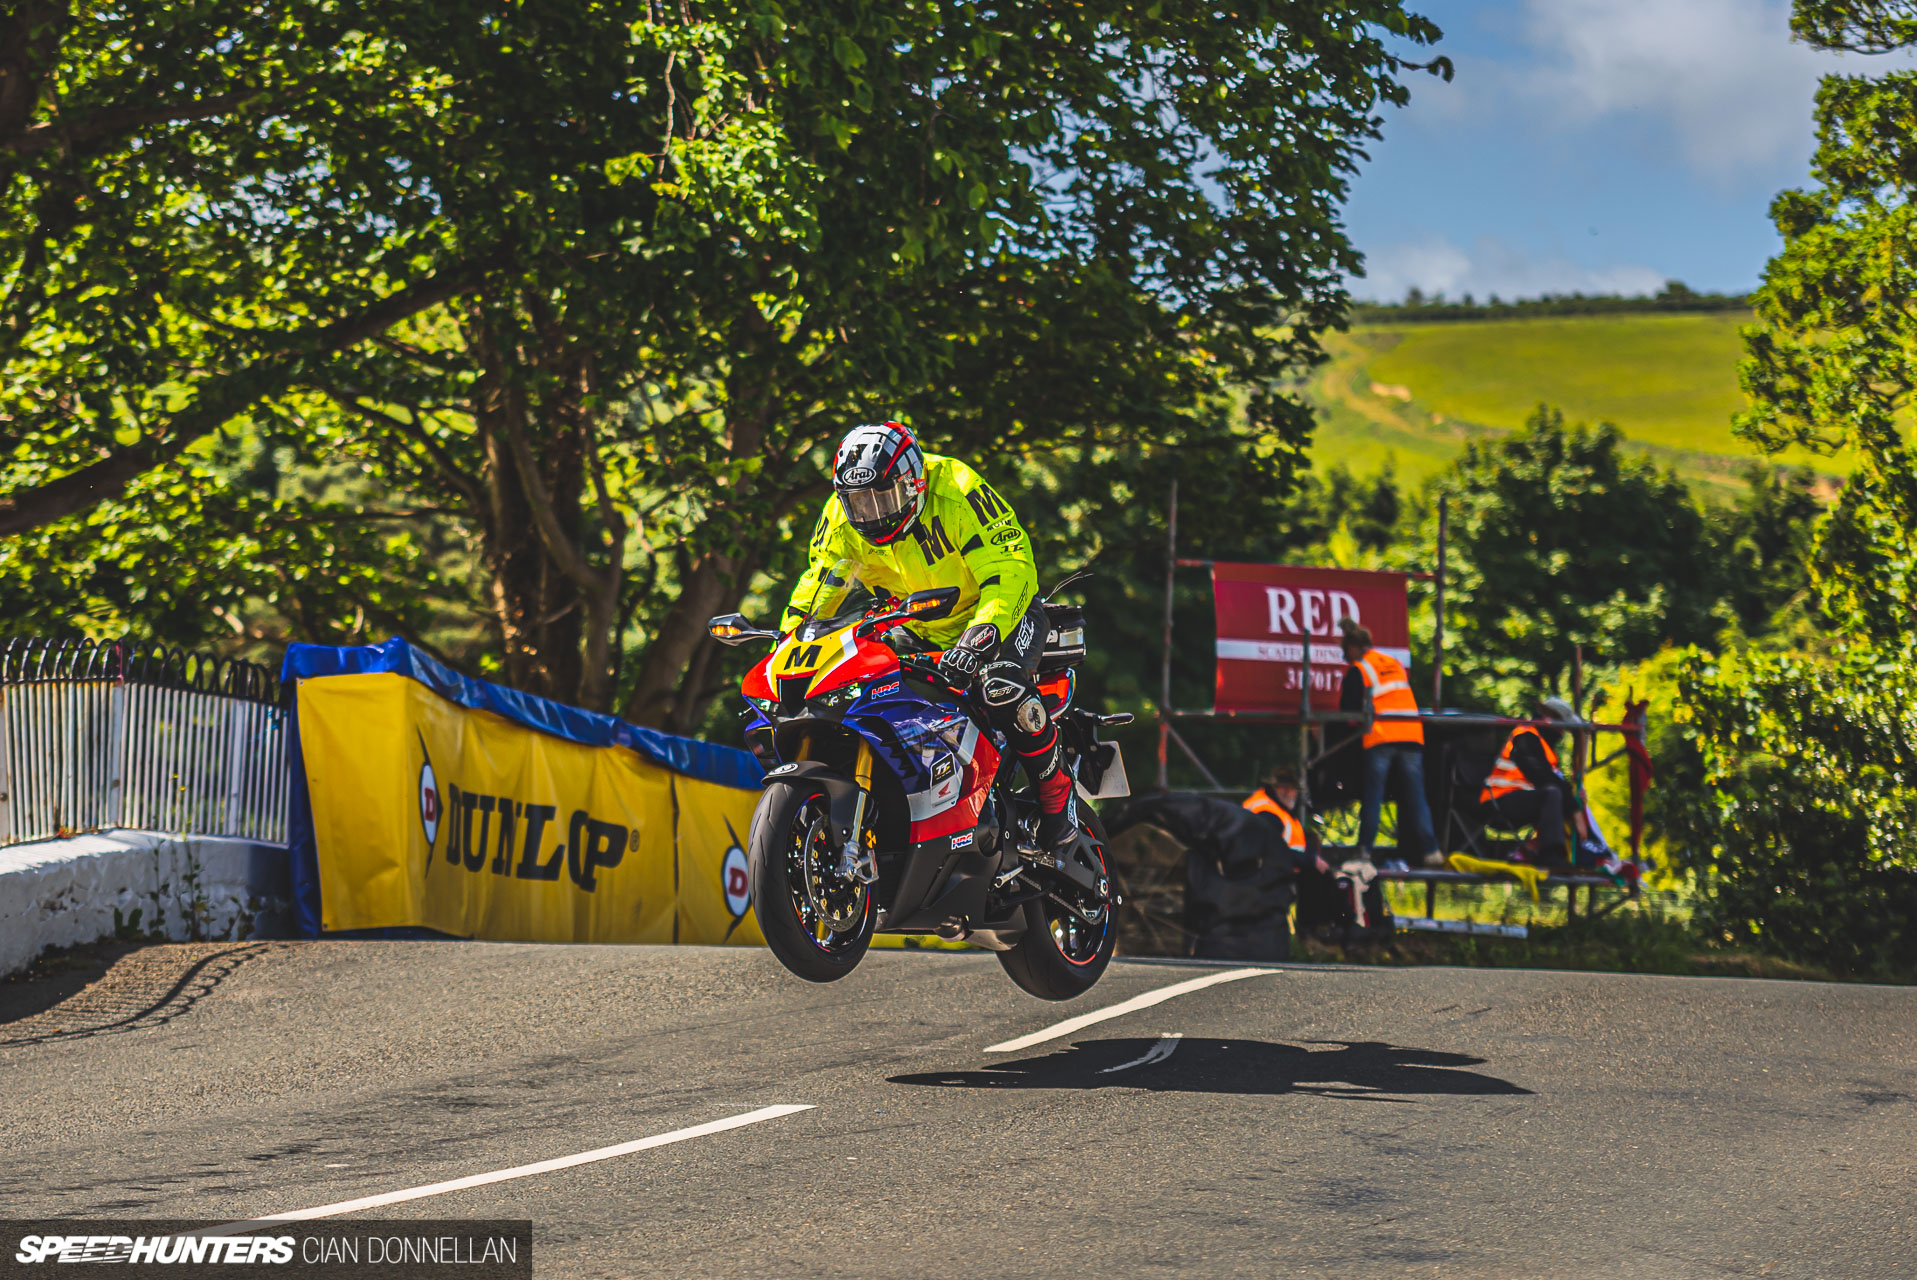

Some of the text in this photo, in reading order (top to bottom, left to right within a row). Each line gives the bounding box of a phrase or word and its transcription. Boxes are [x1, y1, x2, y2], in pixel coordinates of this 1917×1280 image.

[848, 469, 870, 481] Arai
[965, 483, 1010, 527] M
[919, 515, 956, 566] M
[995, 529, 1018, 543] Arai
[1264, 586, 1361, 638] RED
[783, 644, 823, 670] M
[871, 681, 900, 700] HRC
[952, 832, 973, 850] HRC
[728, 866, 749, 899] D
